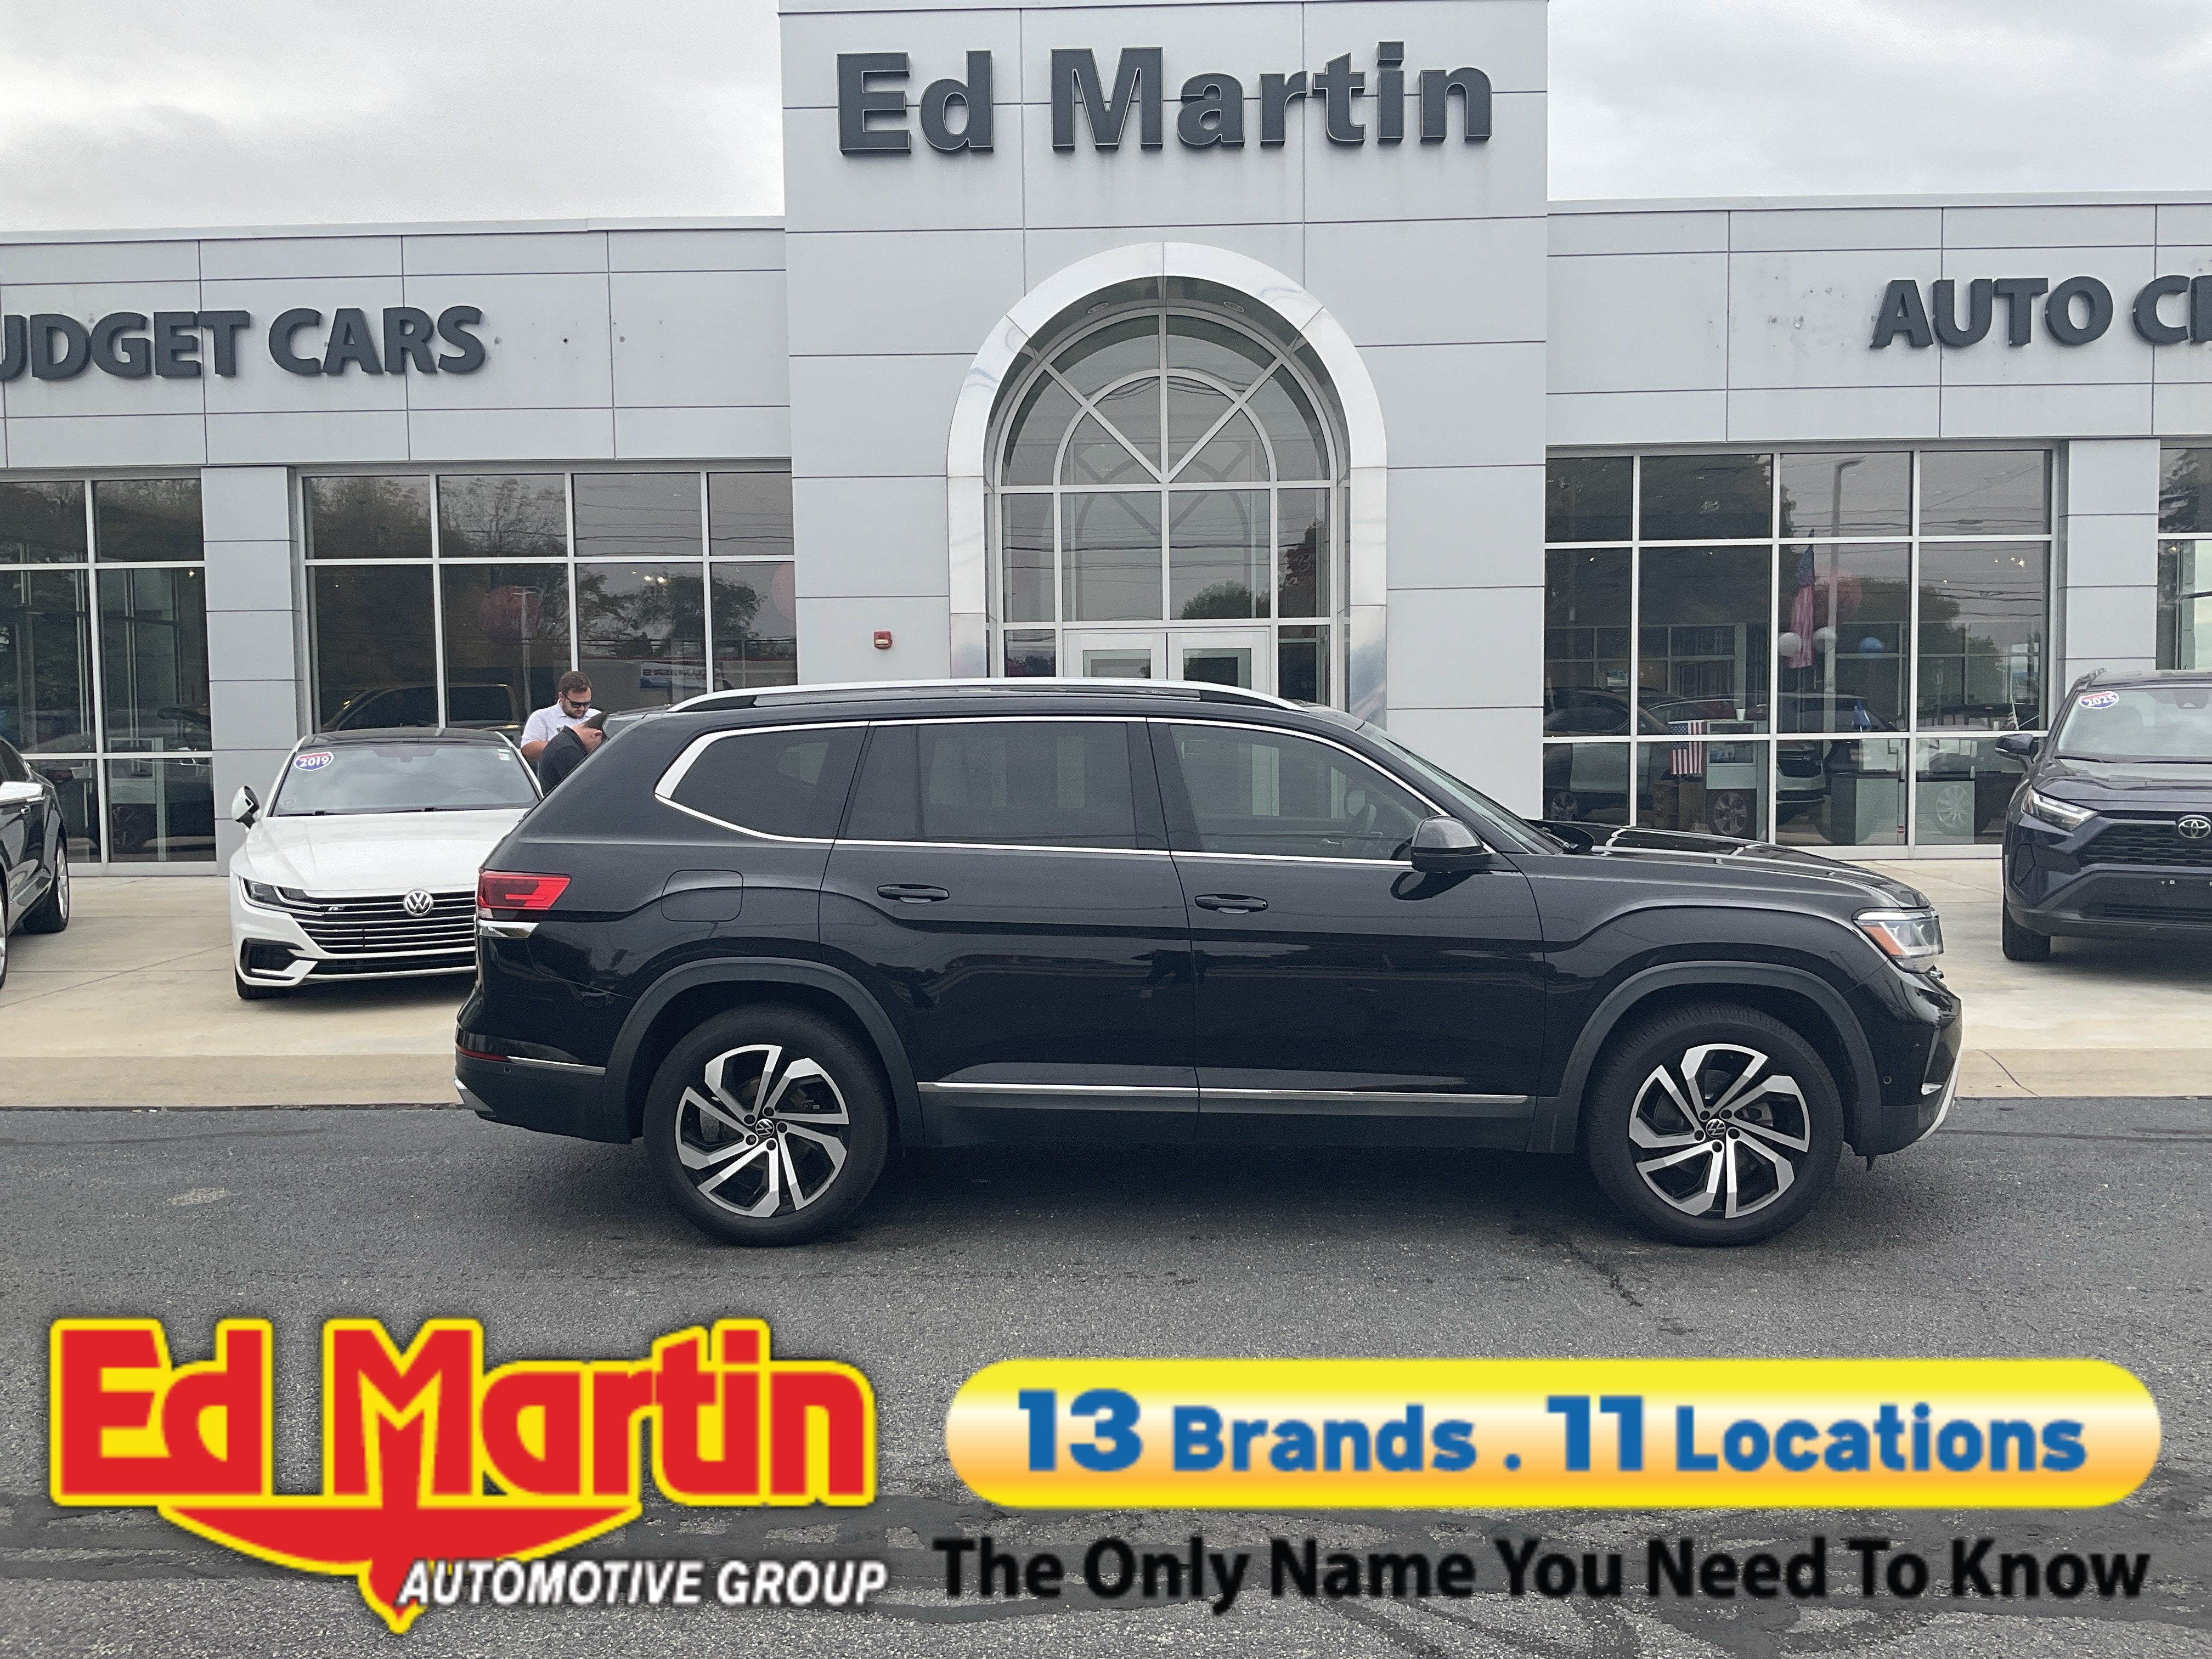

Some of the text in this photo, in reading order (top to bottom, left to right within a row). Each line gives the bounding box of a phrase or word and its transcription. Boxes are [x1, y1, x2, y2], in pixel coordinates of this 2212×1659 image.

[837, 41, 1492, 155] Ed Martin
[268, 306, 486, 378] CARS
[1870, 276, 2114, 348] AUTO
[2085, 694, 2117, 707] 2025
[299, 756, 330, 768] 2019
